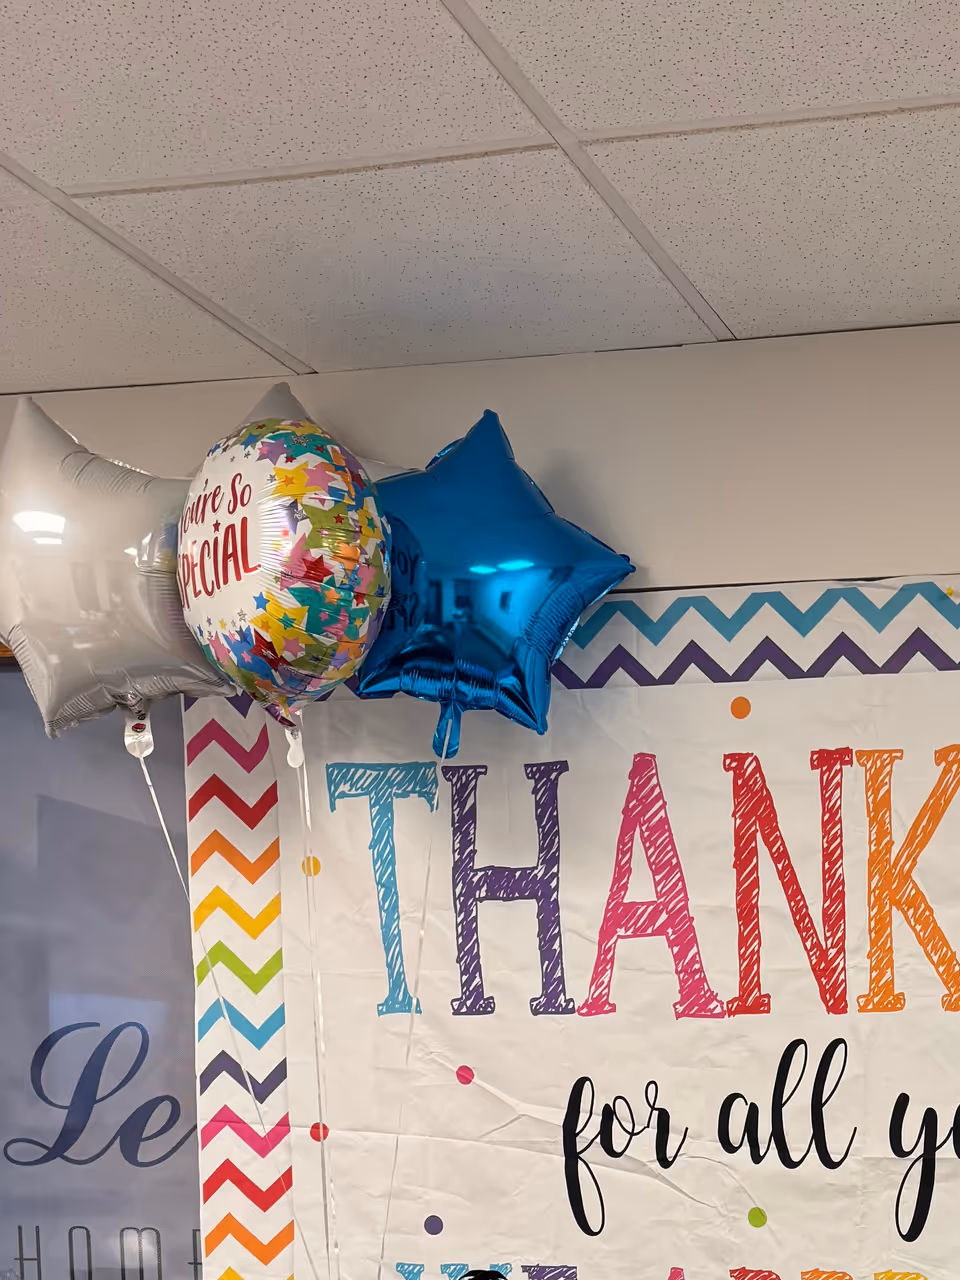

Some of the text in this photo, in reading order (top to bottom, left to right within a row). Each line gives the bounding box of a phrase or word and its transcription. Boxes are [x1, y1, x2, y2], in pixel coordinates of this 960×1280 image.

[228, 473, 252, 515] So
[176, 516, 262, 610] PECIAL
[562, 1076, 688, 1236] for
[717, 1038, 857, 1169] all
